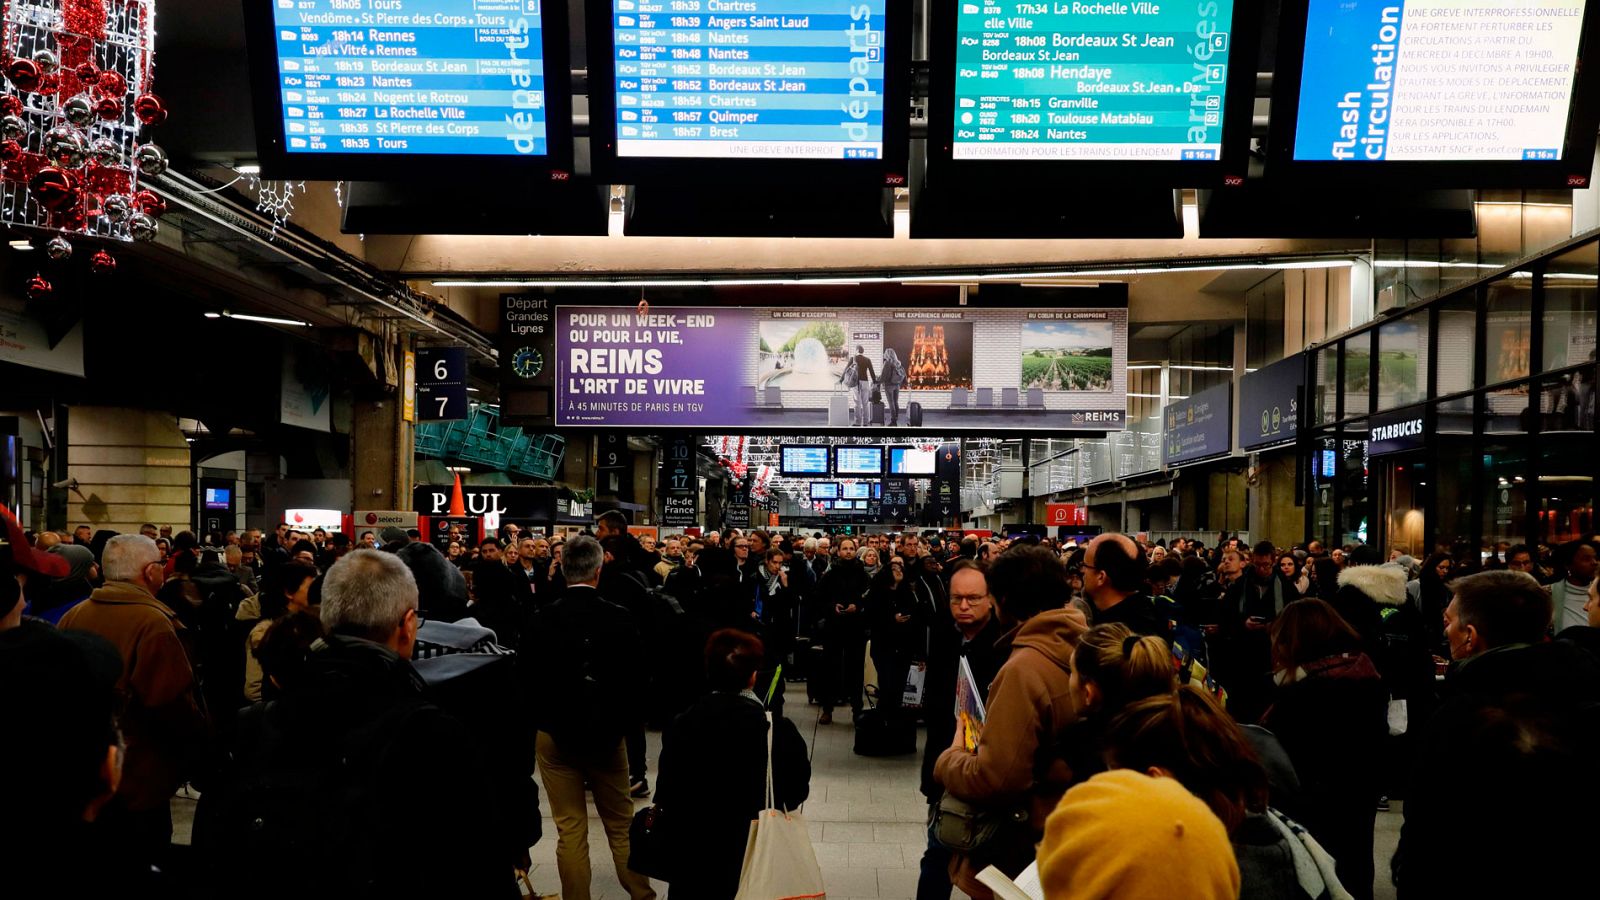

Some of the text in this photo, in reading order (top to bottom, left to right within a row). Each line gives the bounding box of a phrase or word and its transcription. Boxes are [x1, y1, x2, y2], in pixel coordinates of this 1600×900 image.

[1016, 2, 1160, 15] 17h34 La Rochelle Ville
[1408, 8, 1580, 17] UNE GREVE INTERPROFESSIONNELLE
[300, 13, 505, 26] Vendôme St Pierre des Corps Tours
[671, 16, 809, 30] 18h39 Angers Saint Laud
[984, 18, 1033, 29] elle Ville
[1407, 22, 1553, 31] VA FORTEMENT PERTURBER LES
[332, 29, 416, 41] 18h14 Rennes
[1015, 33, 1222, 47] 18h08 Bordeaux St Jean 6
[303, 44, 417, 55] Laval Vitré Rennes
[983, 50, 1080, 61] Bordeaux St Jean
[335, 61, 467, 72] 18h19 Bordeaux St Jean
[841, 4, 876, 141] départs
[1187, 1, 1218, 143] arrivées
[1401, 64, 1428, 73] NOUS
[1431, 64, 1456, 73] VOUS
[1459, 64, 1503, 73] INVITONS
[1514, 64, 1570, 73] PRIVILEGIER
[1013, 65, 1219, 82] 18h08 Hendaye 6
[336, 76, 412, 87] 18h23 Nantes
[505, 18, 540, 153] départs
[672, 80, 806, 91] 18h52 Bordeaux St Jean
[1361, 6, 1400, 159] circulation
[338, 107, 465, 119] 18h27 La Rochelle Ville
[1396, 105, 1550, 114] POUR LES TRAINS DU LENDEMAIN
[673, 111, 758, 124] 18h57 Quimper
[1011, 114, 1040, 124] 18h20
[1048, 113, 1098, 124] Toulouse
[1101, 113, 1153, 124] Matabiau
[340, 122, 479, 136] 18h35 St Pierre des Corps
[673, 126, 738, 137] 18h57 Brest
[1332, 92, 1362, 160] flash
[1010, 129, 1087, 139] 18h24 Nantes
[1393, 132, 1411, 140] SUR
[1413, 132, 1430, 140] LES
[341, 138, 408, 148] 18h35 Tours
[507, 297, 548, 310] Départ
[507, 312, 548, 321] Grandes
[570, 314, 715, 328] POUR UN WEEK-END
[511, 324, 544, 335] Lignes
[570, 330, 683, 344] OU POUR LA VIE,
[571, 349, 663, 374] REIMS
[434, 360, 447, 380] 6
[570, 379, 705, 394] L'ART DE VIVRE
[435, 397, 448, 417] 7
[569, 400, 704, 412] À 45 MINUTES DE PARIS EN TGV
[1372, 419, 1422, 442] STARBUCKS
[672, 446, 688, 458] 10
[609, 453, 617, 465] 9
[672, 475, 688, 488] 17
[667, 497, 693, 506] Ile-de
[665, 506, 694, 514] France
